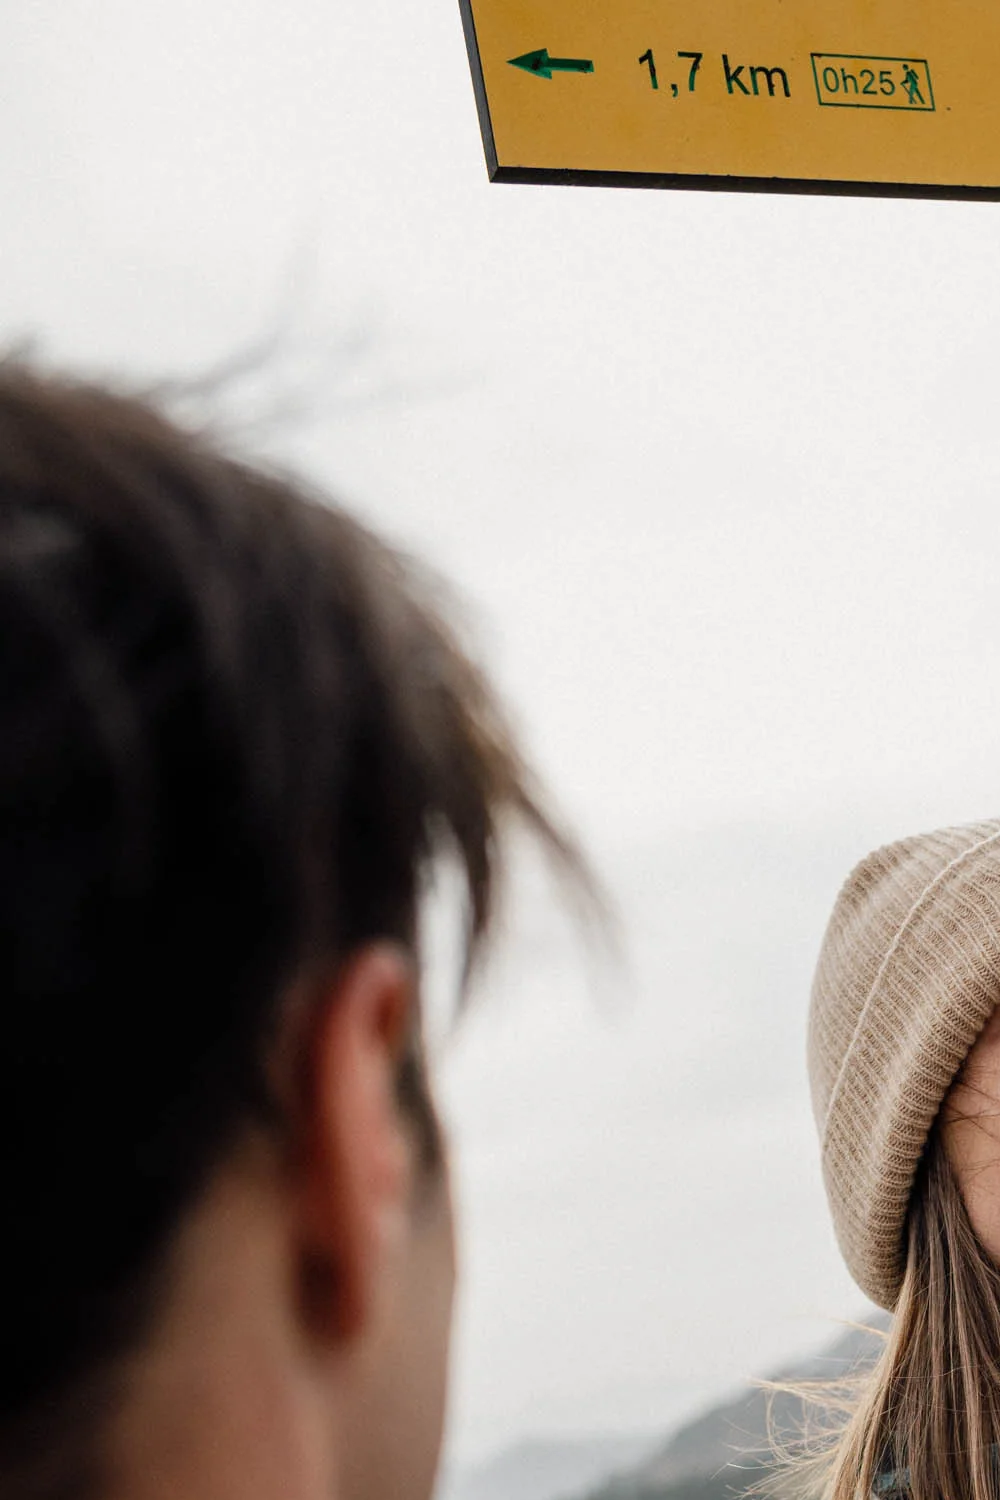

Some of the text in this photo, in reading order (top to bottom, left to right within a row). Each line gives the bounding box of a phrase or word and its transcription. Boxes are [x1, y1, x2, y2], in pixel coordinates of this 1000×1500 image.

[638, 48, 895, 98] 1,7 km 0h25
